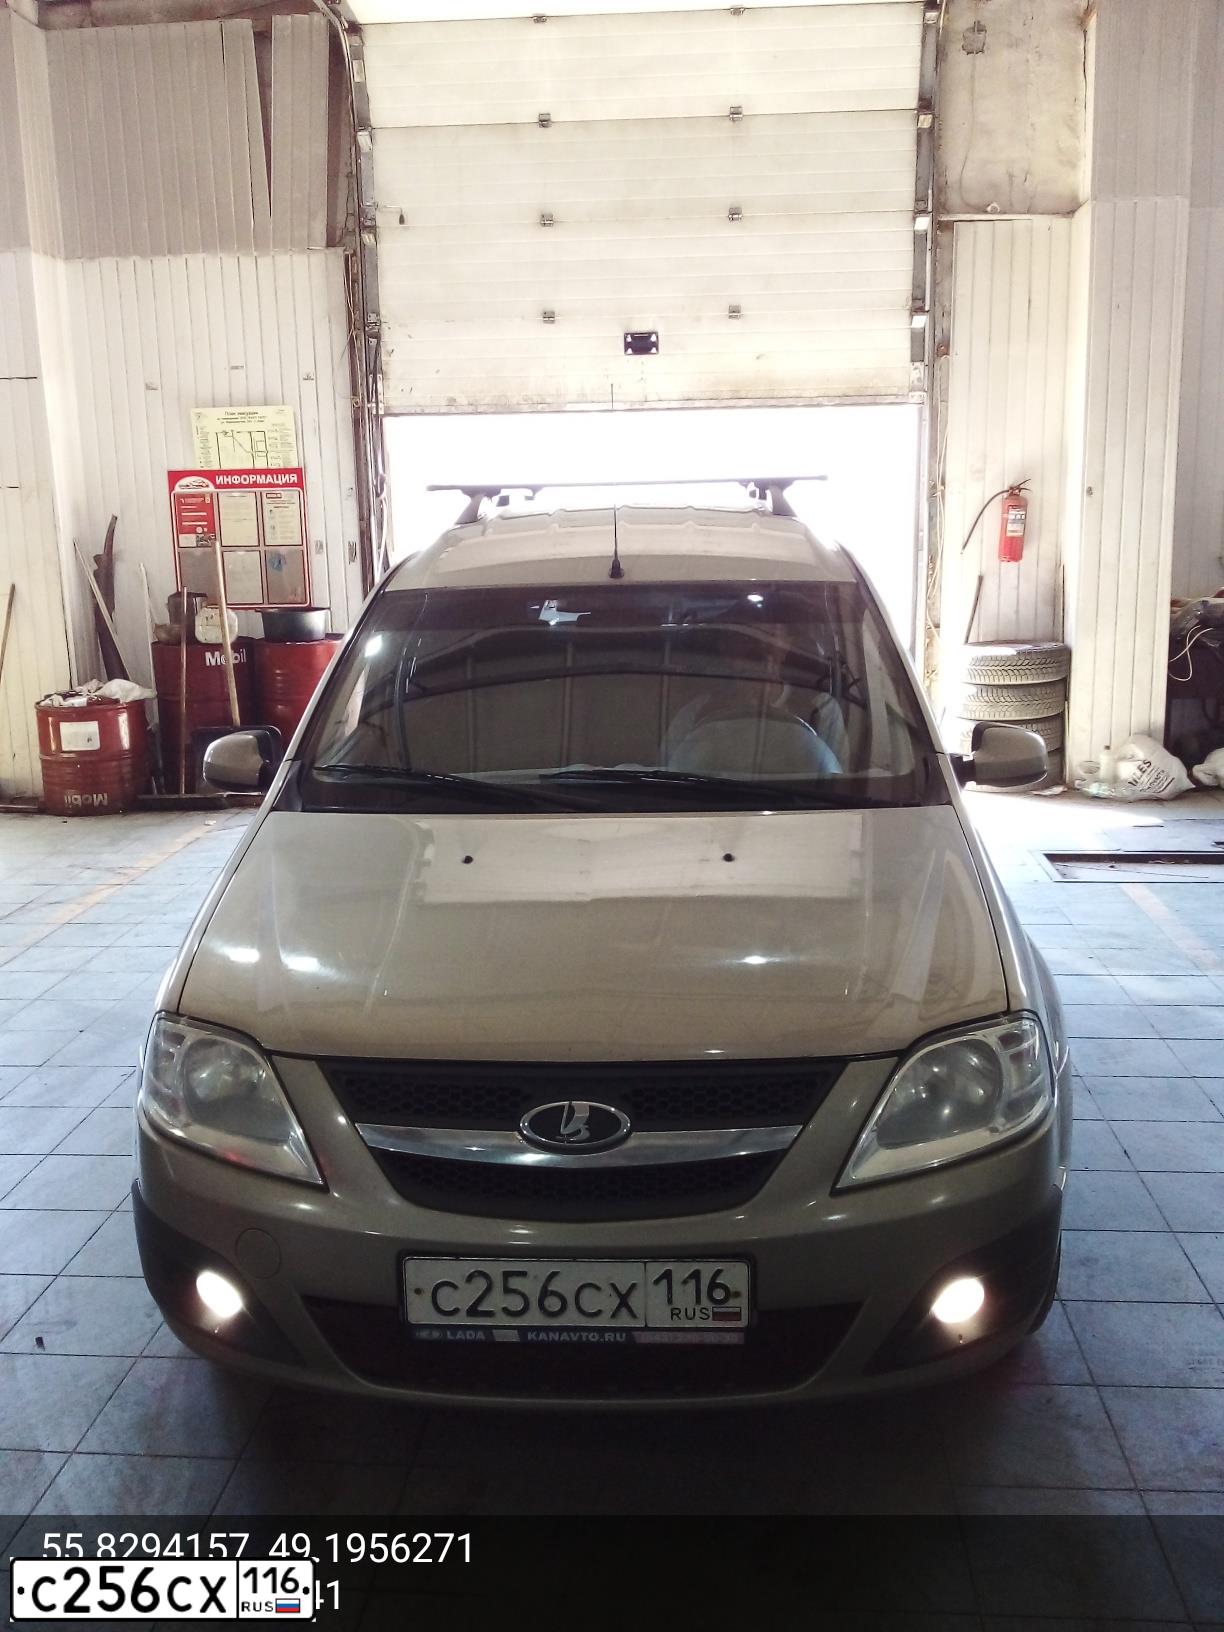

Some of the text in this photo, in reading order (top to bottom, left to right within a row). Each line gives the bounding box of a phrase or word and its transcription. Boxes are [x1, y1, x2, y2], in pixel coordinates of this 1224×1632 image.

[215, 474, 298, 486] ИНФОРМАЦИЯ
[64, 793, 108, 807] Mobil
[431, 1268, 731, 1319] С256СХ 116
[670, 1307, 710, 1321] RUS
[446, 1330, 485, 1341] LADA
[527, 1331, 627, 1343] KANAVTO.RU
